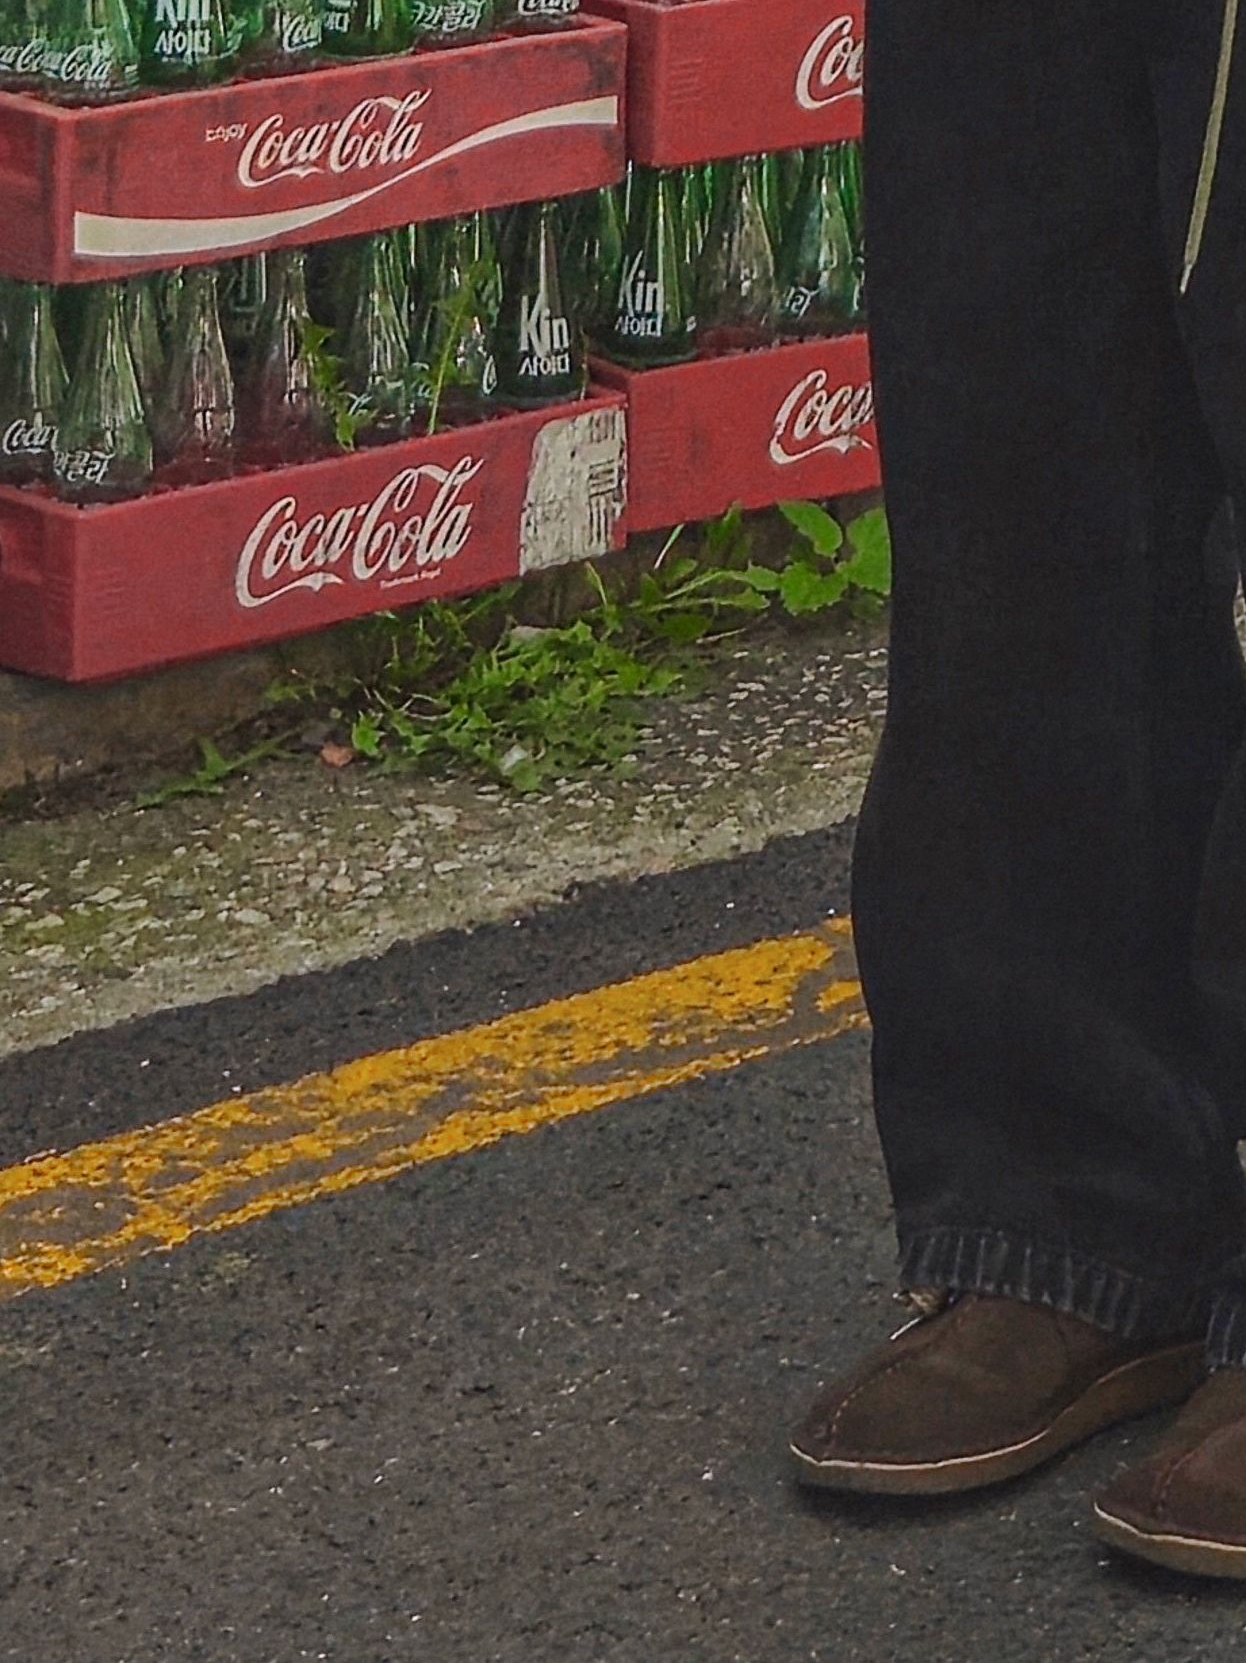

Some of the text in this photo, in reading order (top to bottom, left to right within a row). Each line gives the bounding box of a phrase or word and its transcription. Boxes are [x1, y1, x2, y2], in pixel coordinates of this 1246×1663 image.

[154, 28, 211, 56] 사이다
[237, 87, 433, 189] Coca-Cola
[617, 249, 666, 317] Kin
[519, 293, 571, 360] Kin
[518, 352, 572, 378] 사이다
[235, 454, 485, 609] Coca-Cola
